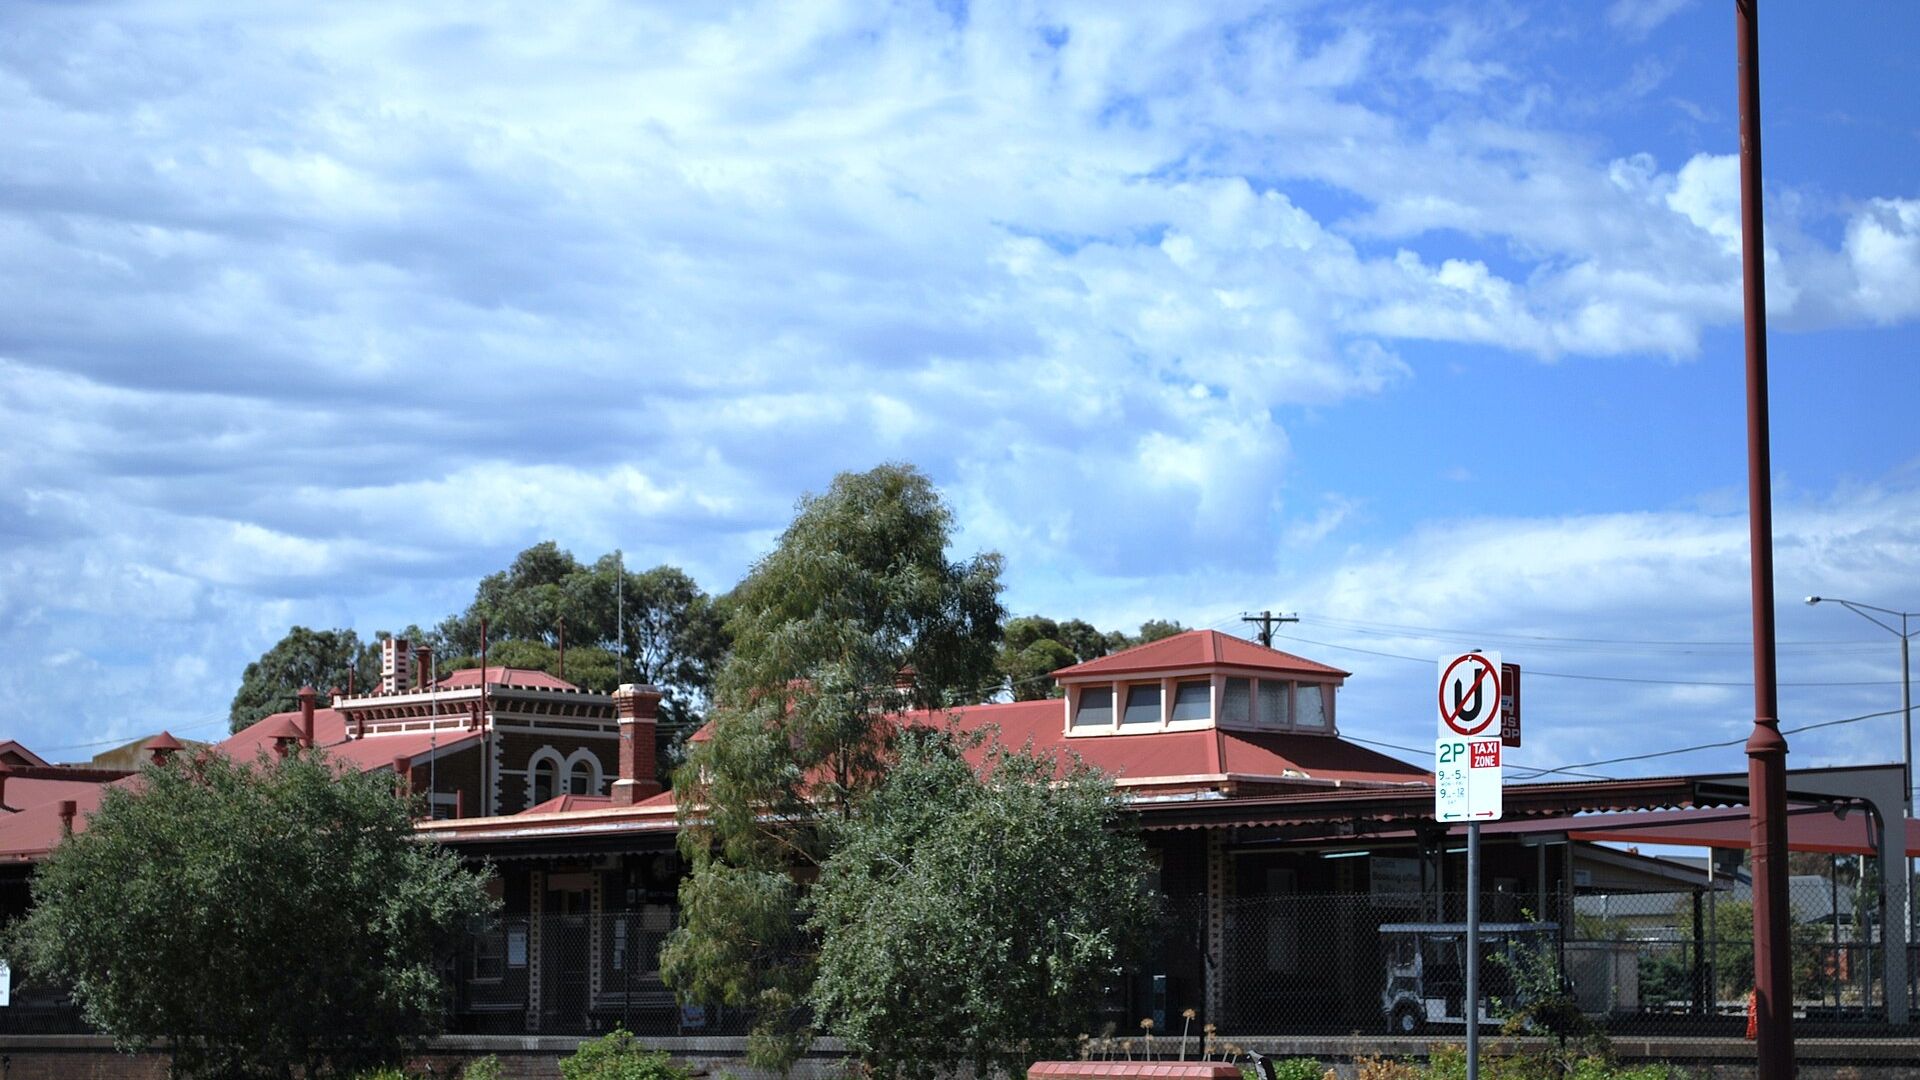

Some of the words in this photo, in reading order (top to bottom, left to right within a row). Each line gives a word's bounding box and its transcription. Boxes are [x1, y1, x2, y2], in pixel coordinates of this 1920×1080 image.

[1501, 716, 1516, 727] US
[1502, 727, 1520, 739] OP
[1439, 743, 1465, 763] 2P
[1473, 742, 1497, 754] TAXI
[1474, 755, 1496, 767] ZONE
